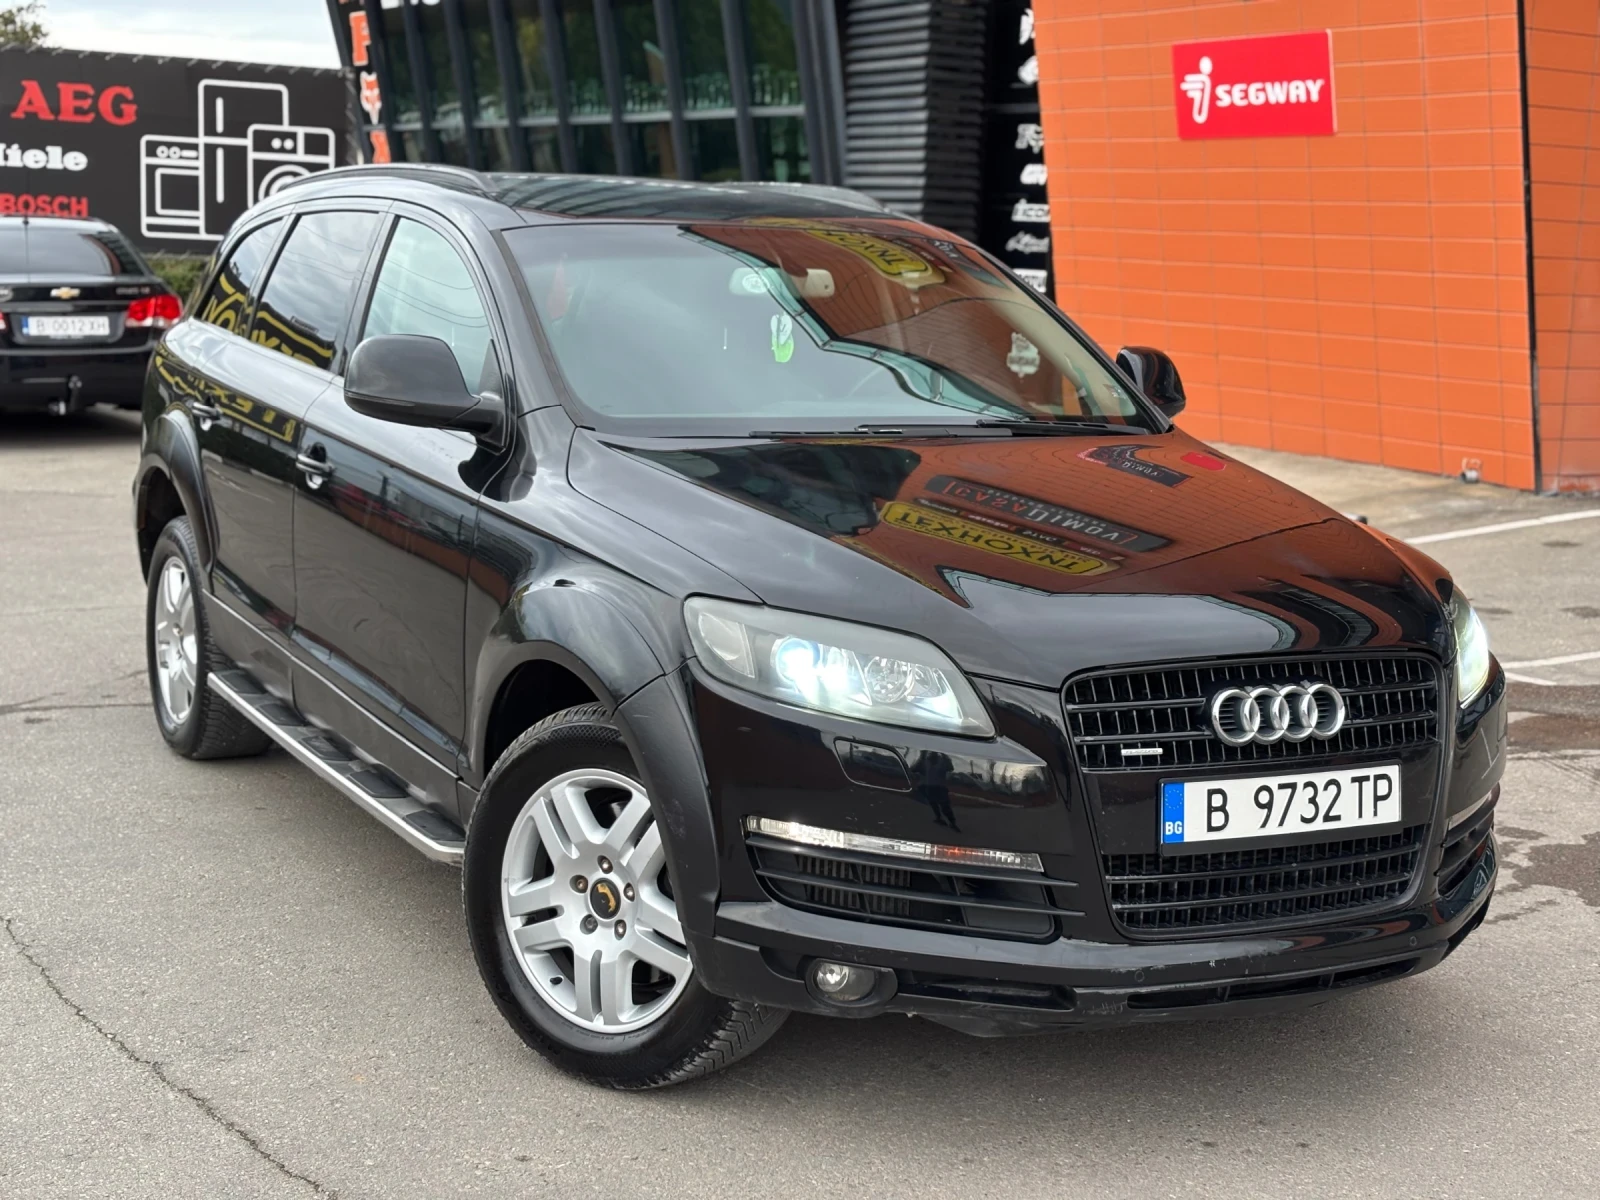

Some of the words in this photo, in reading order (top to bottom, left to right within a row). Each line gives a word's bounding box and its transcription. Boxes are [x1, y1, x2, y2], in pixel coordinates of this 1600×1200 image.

[10, 79, 138, 126] AEG
[1215, 79, 1325, 107] SEGWAY
[0, 193, 89, 218] BOSCH
[1206, 788, 1230, 833] B
[1253, 778, 1342, 829] 9732
[1350, 773, 1393, 819] TP
[1165, 821, 1183, 836] BG
